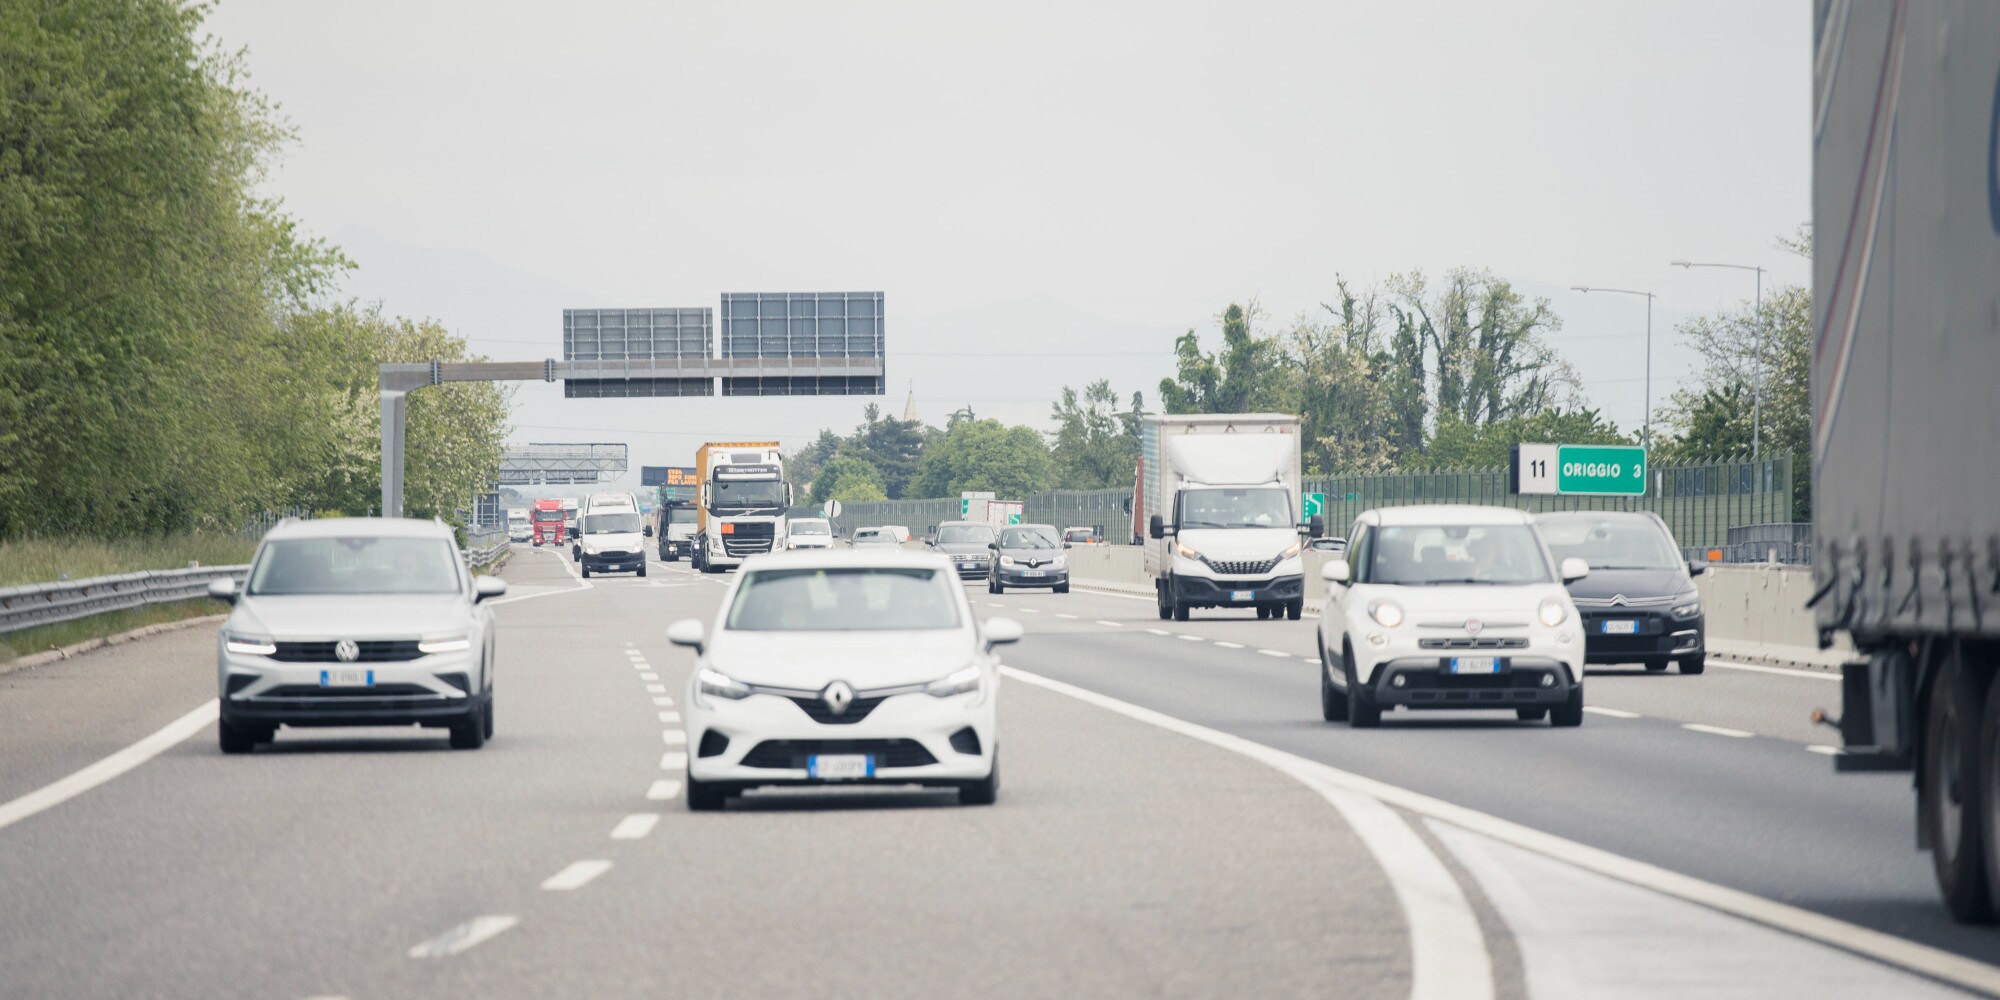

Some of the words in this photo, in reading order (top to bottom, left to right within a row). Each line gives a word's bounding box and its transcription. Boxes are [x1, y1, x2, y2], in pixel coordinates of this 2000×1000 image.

[1531, 459, 1545, 478] 11
[1562, 462, 1621, 478] ORIGGIO
[1633, 464, 1642, 478] 3
